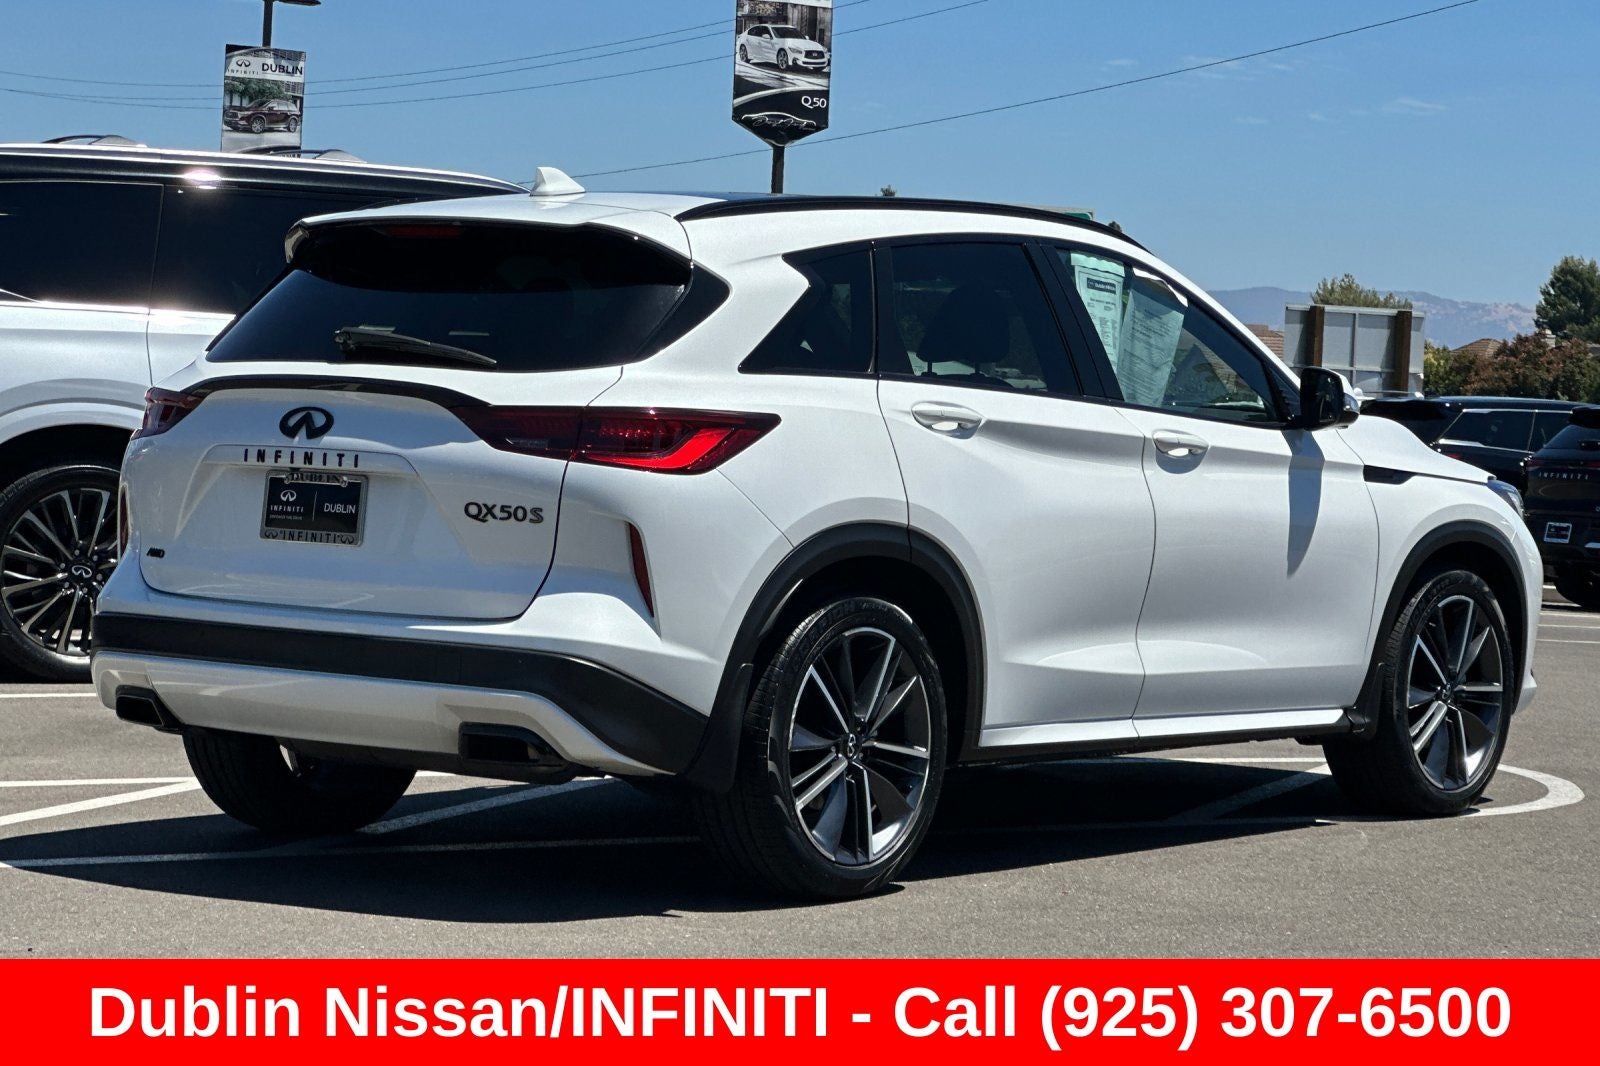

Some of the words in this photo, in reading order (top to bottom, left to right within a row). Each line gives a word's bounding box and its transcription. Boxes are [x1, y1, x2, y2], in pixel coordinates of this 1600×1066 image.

[227, 68, 259, 76] INFINITI
[261, 62, 303, 76] DUBLIN
[801, 95, 827, 109] Q50
[243, 448, 359, 468] INFINITI
[1538, 471, 1590, 480] INFINITI
[270, 504, 304, 513] INFINITI
[323, 502, 356, 515] DUBLIN
[282, 530, 338, 544] INFINITI
